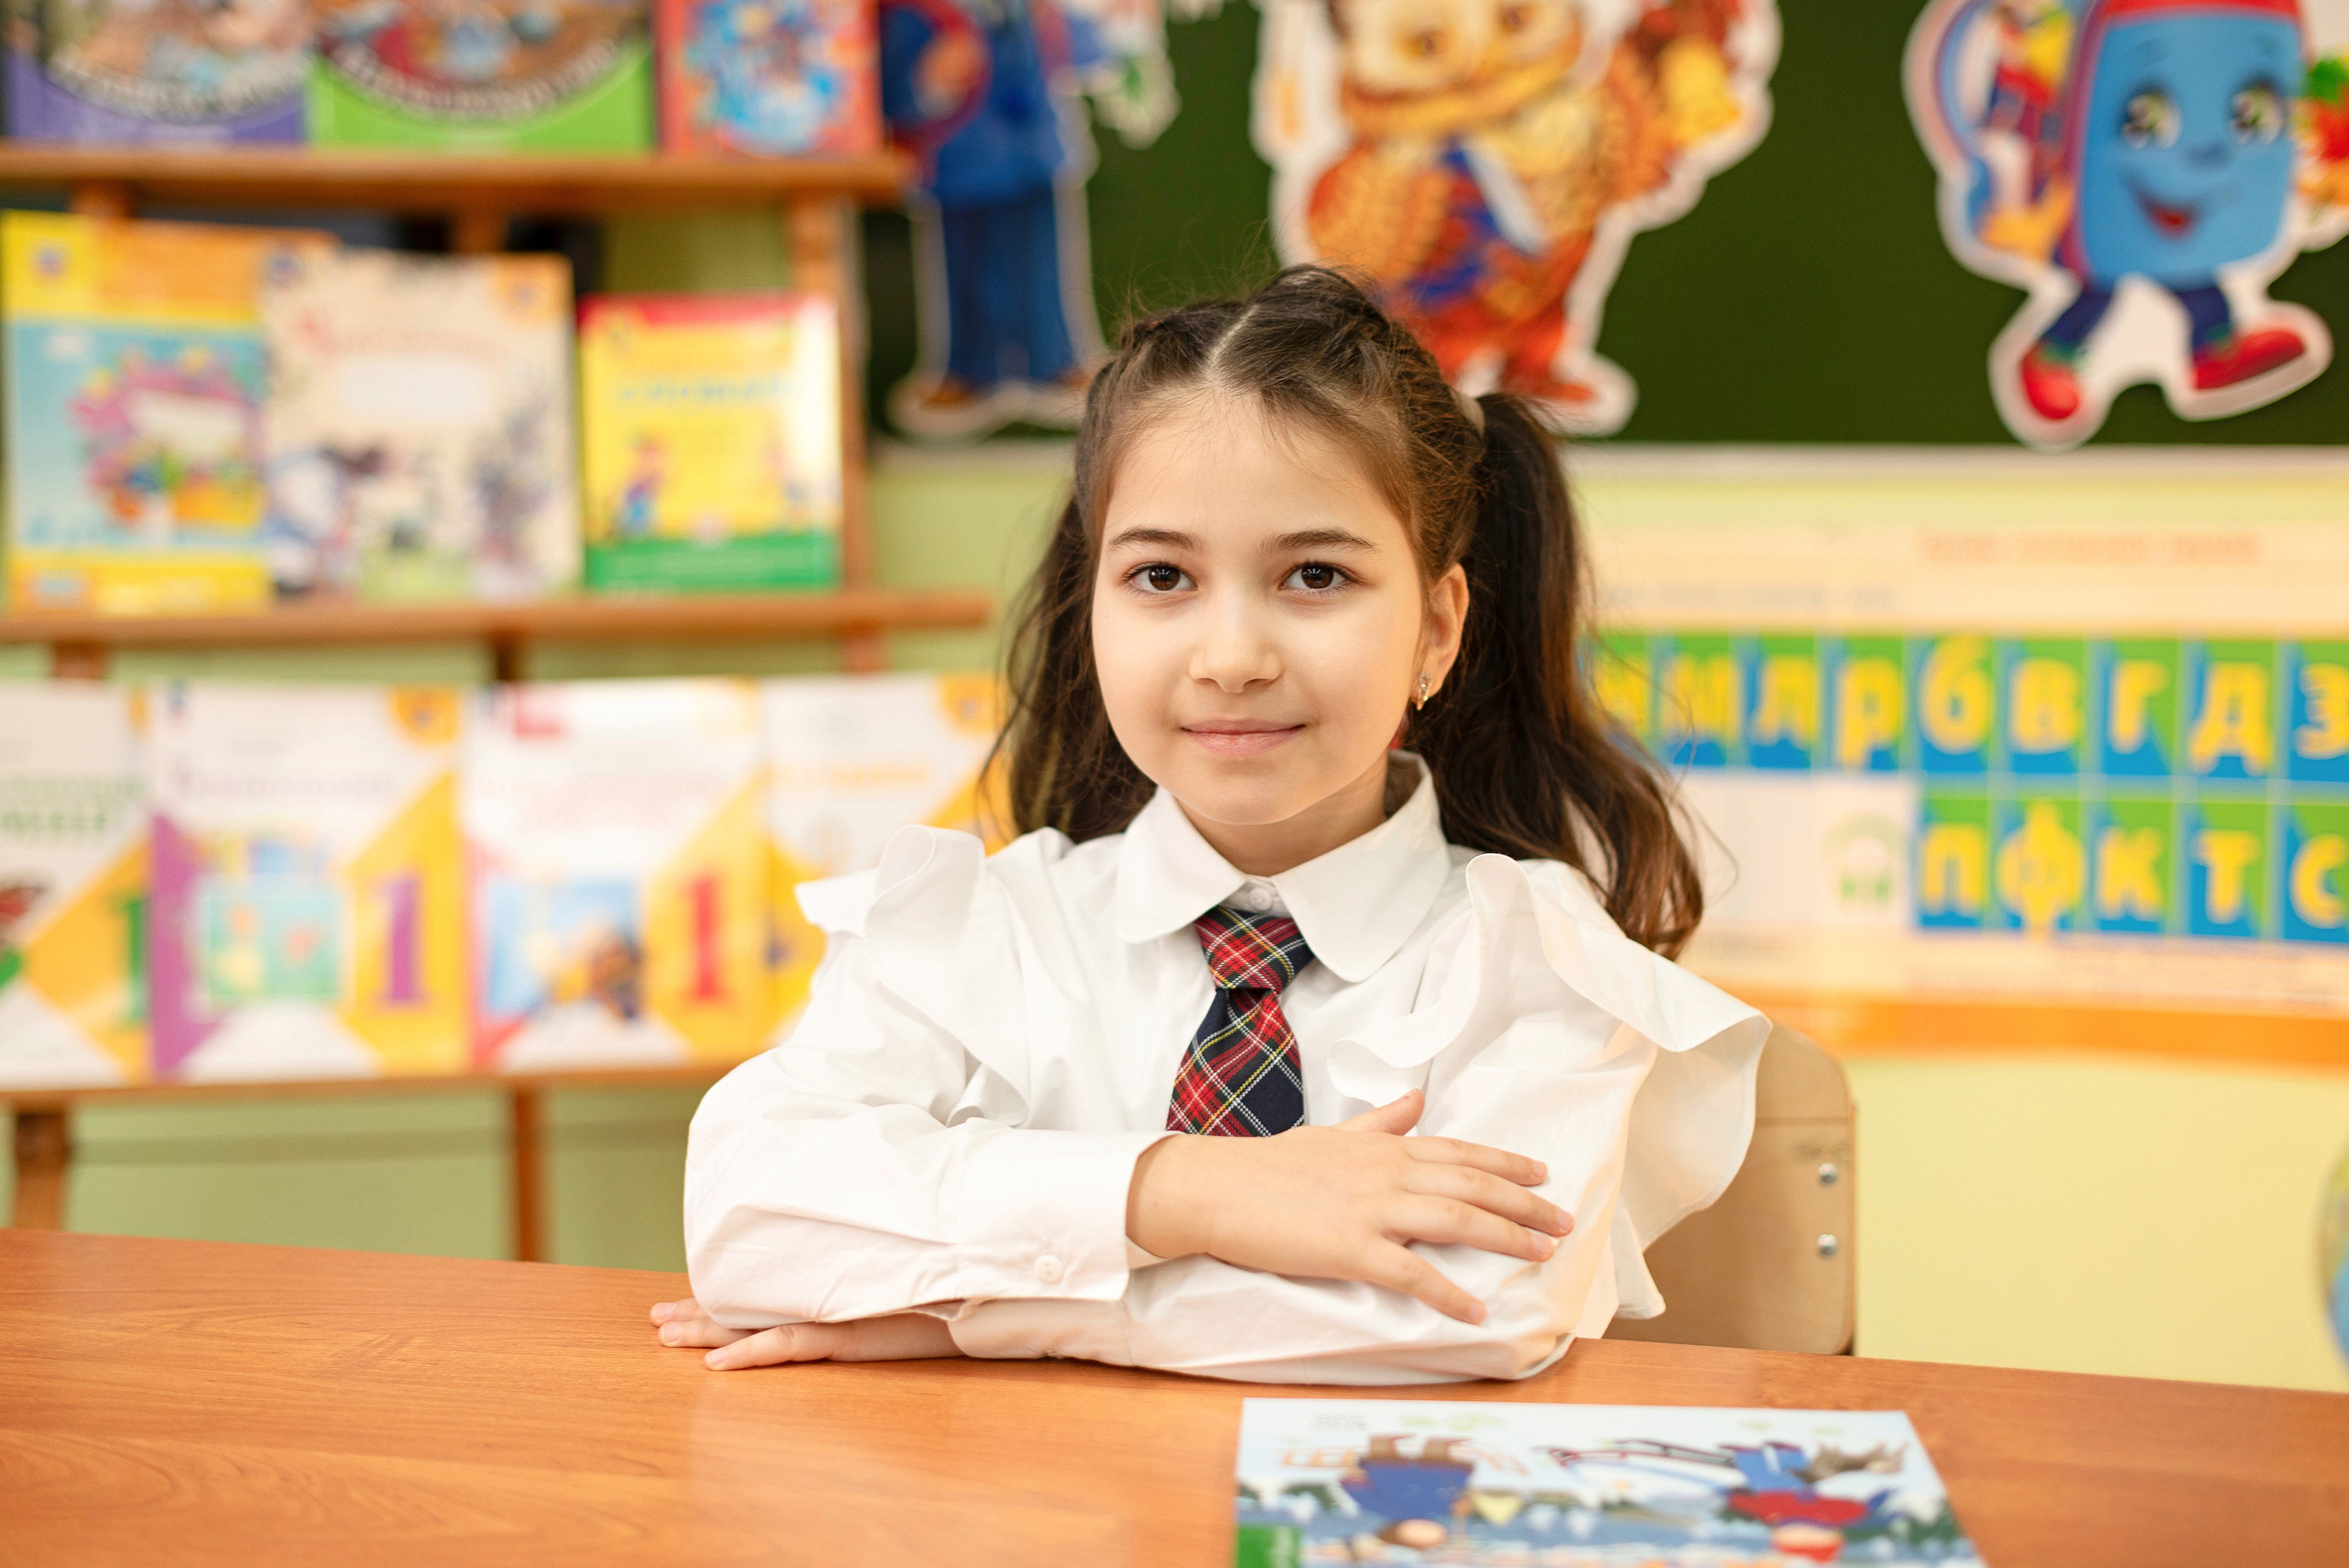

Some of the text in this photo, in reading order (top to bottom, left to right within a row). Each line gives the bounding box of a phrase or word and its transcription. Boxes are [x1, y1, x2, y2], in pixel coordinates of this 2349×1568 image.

[1756, 655, 1819, 747] л
[1840, 659, 1901, 769] р
[1923, 631, 1992, 754] б
[2011, 659, 2083, 754] в
[2110, 659, 2169, 755] г
[2190, 661, 2274, 775] д
[2297, 662, 2349, 760] з
[372, 873, 429, 1009] 1
[675, 872, 740, 1006] 1
[1923, 798, 2349, 945] п ф к т с
